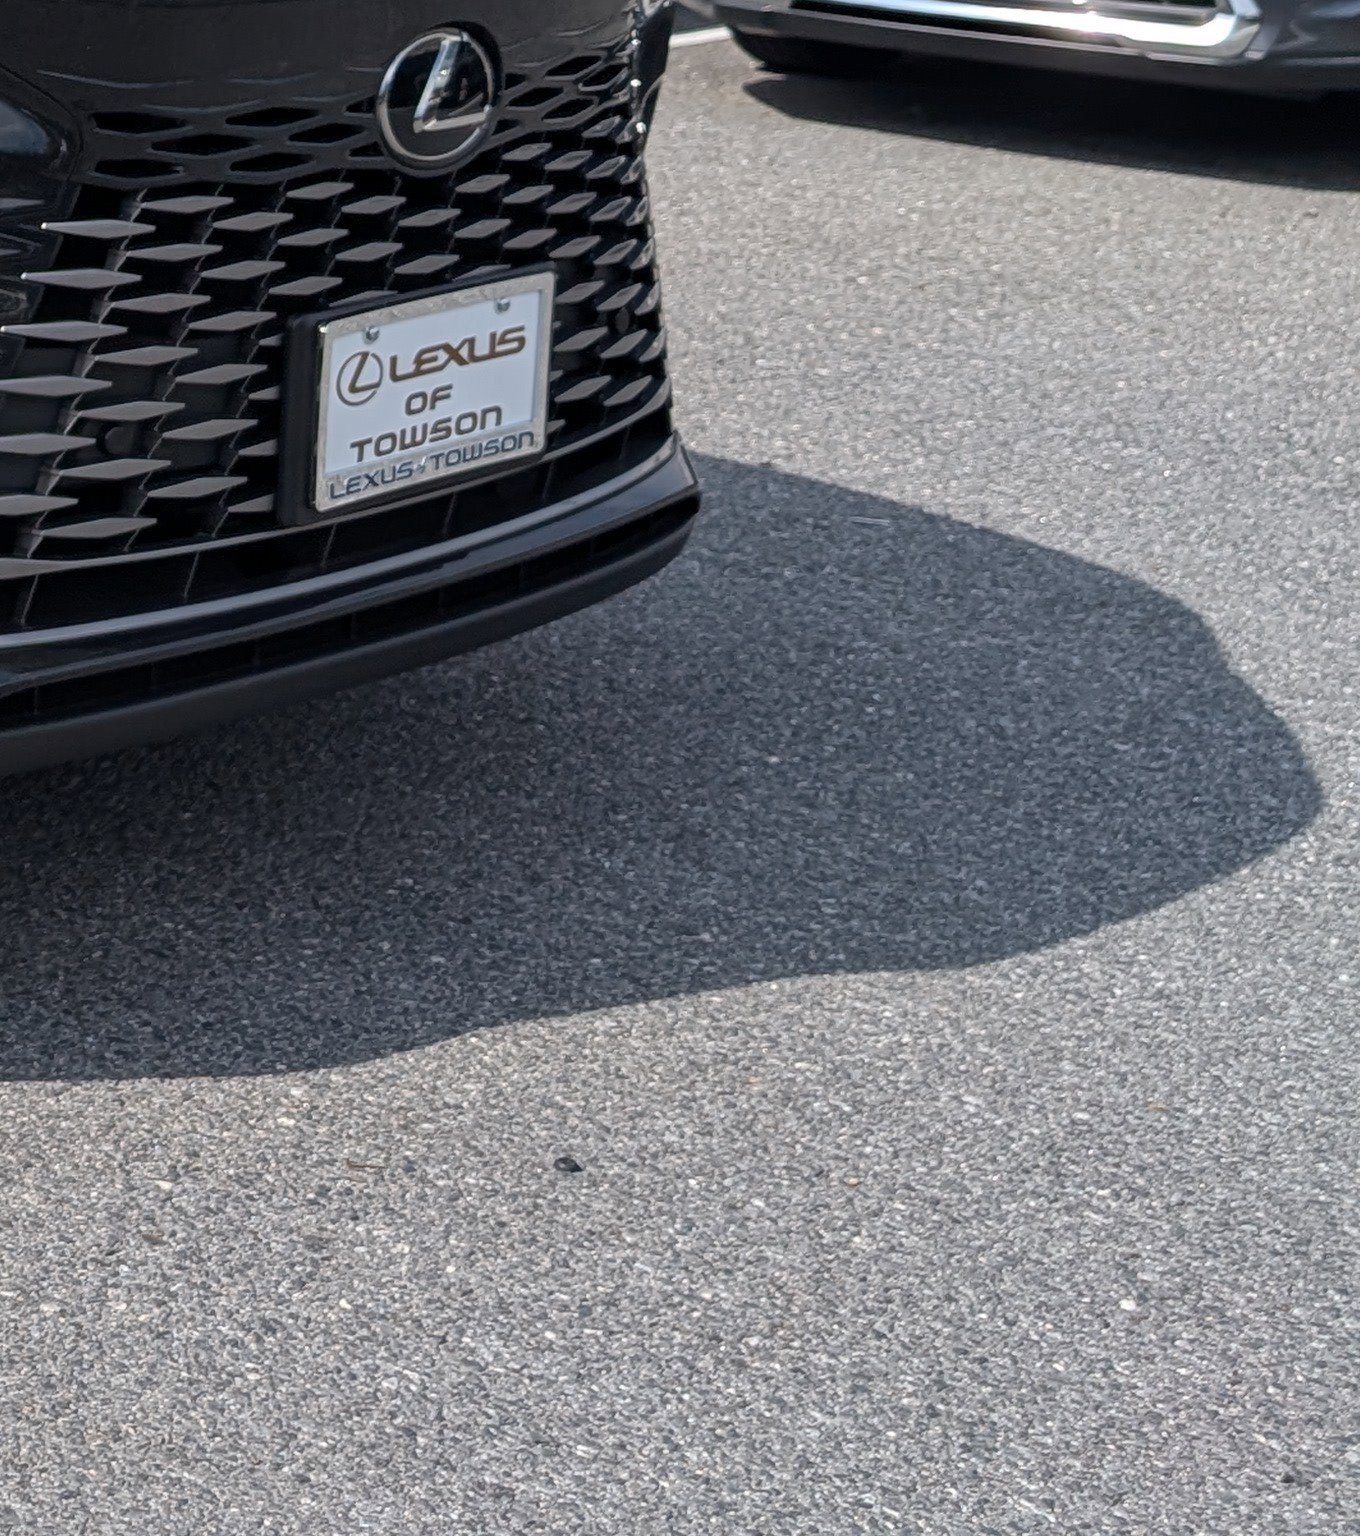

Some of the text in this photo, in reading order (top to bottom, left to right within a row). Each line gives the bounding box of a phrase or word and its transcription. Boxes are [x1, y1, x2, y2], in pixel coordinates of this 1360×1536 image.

[389, 325, 527, 382] LEXUS
[405, 383, 454, 416] OF
[350, 405, 503, 463] TOWSON
